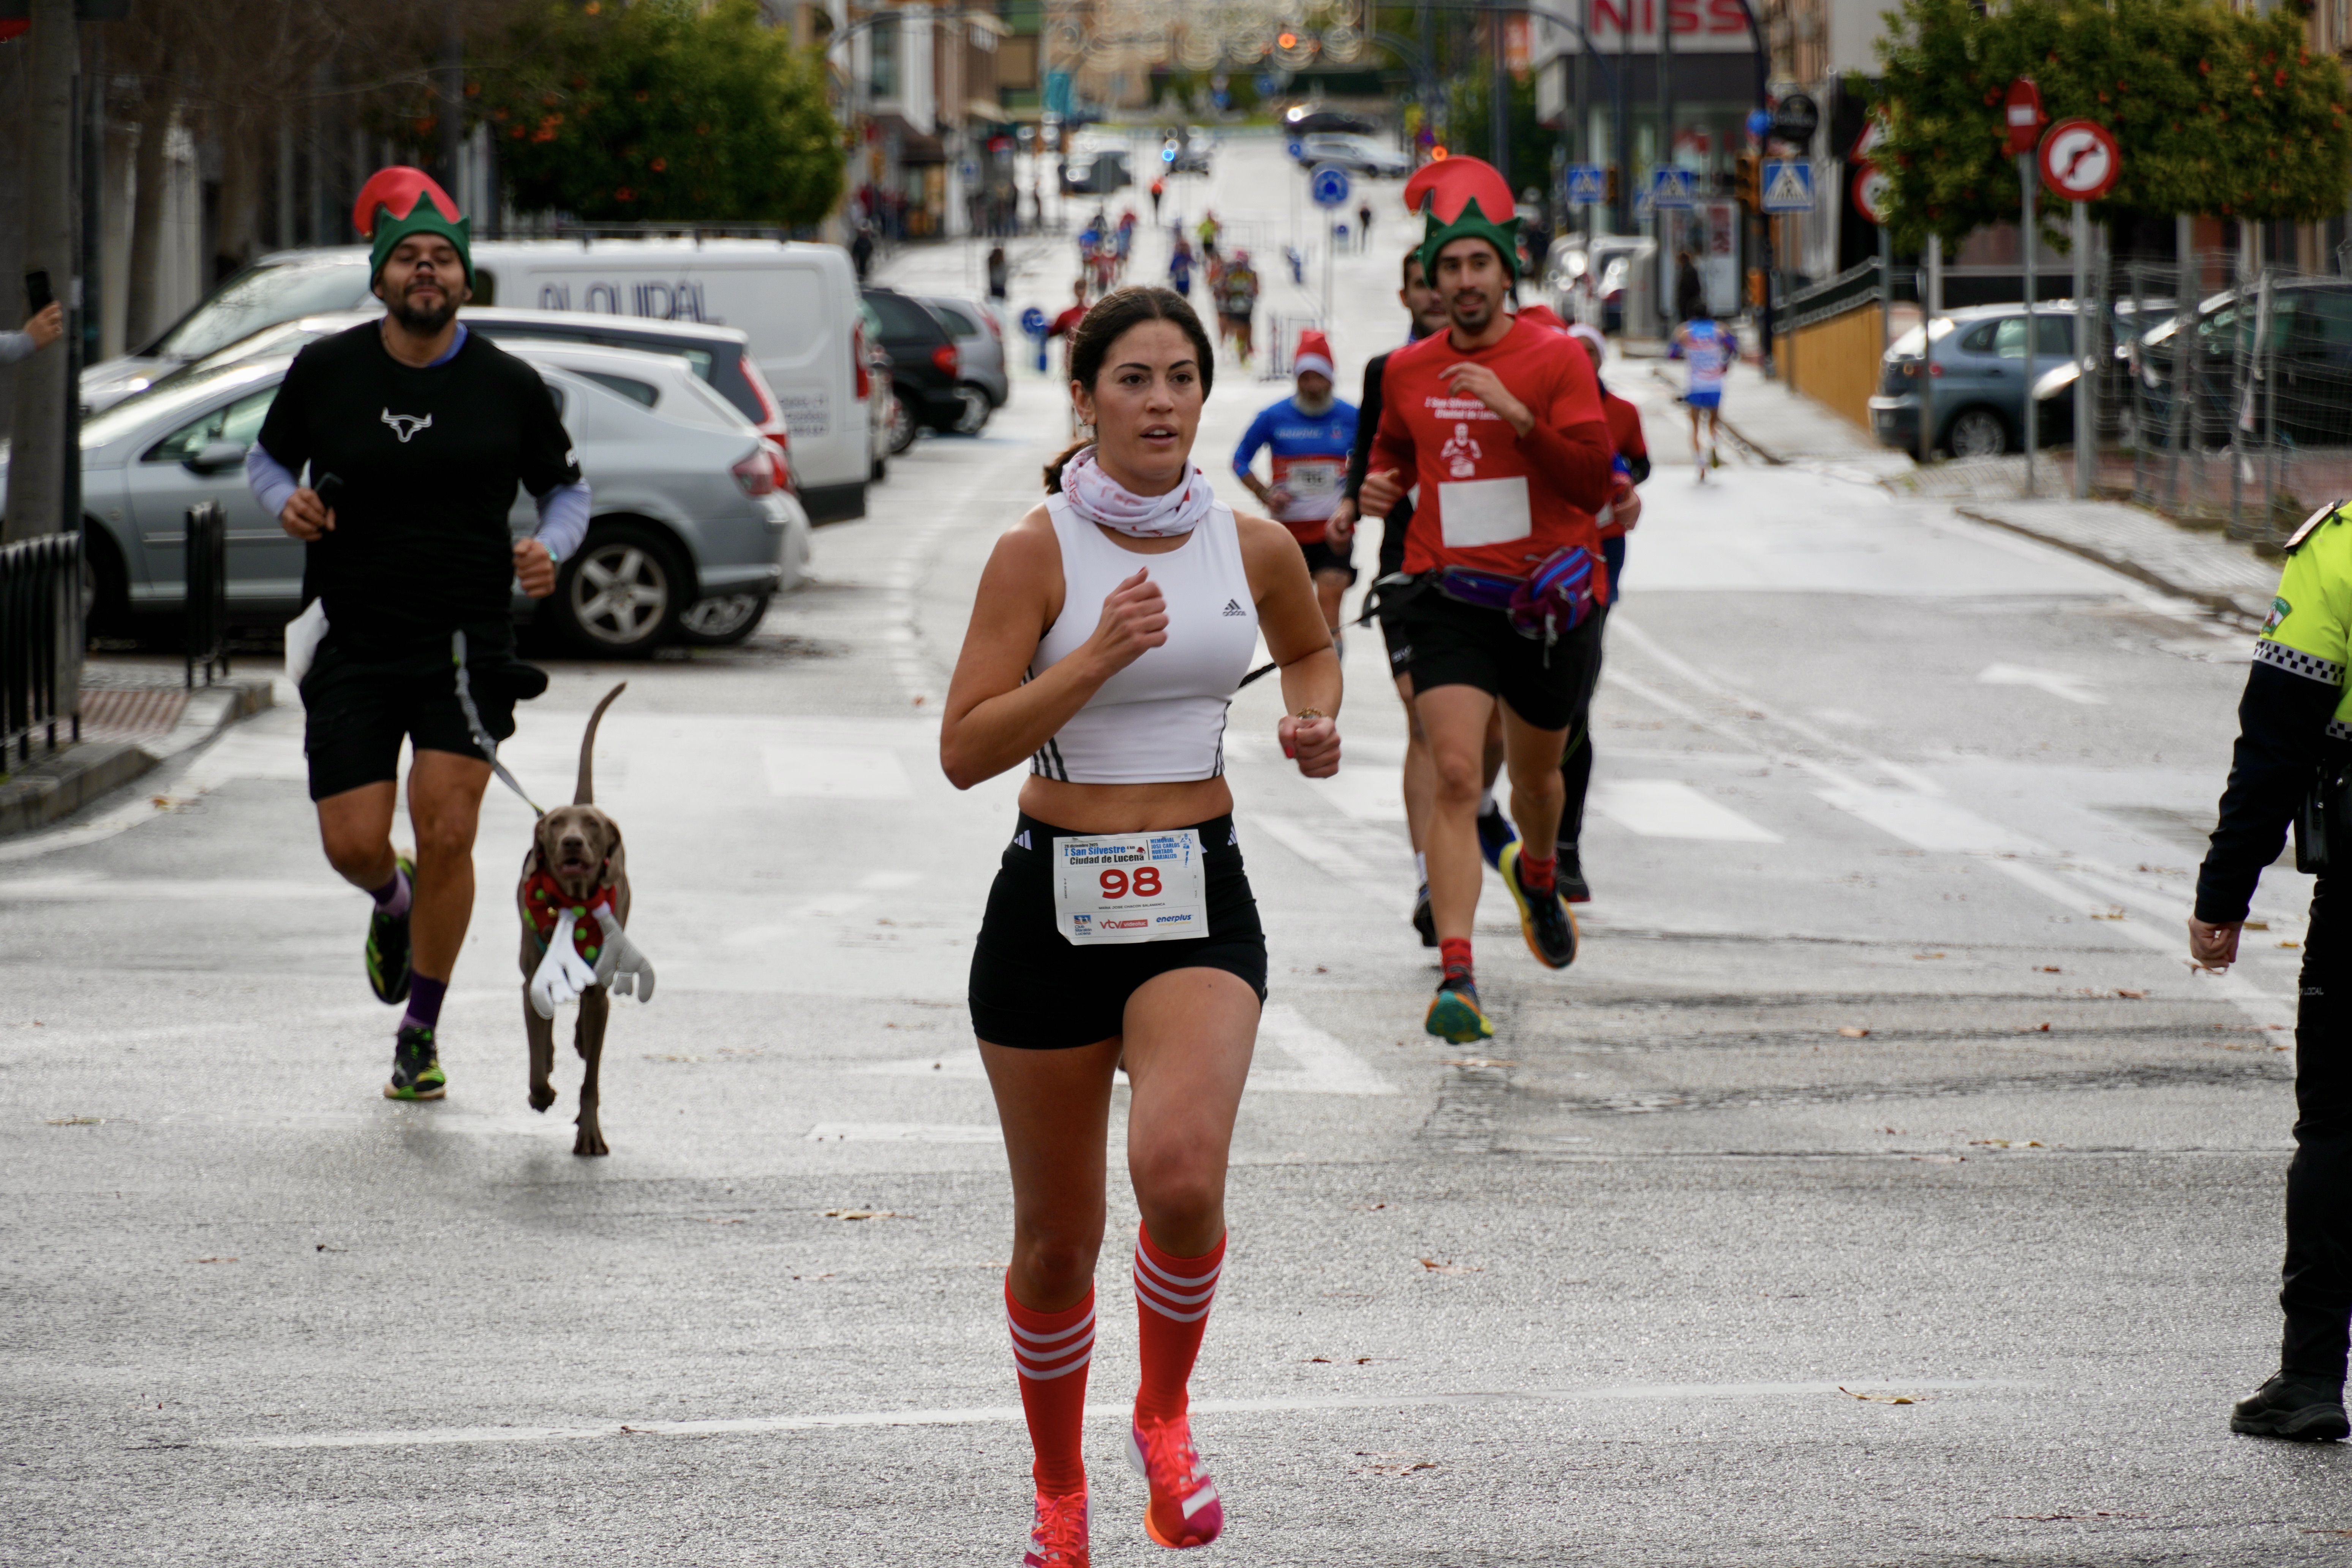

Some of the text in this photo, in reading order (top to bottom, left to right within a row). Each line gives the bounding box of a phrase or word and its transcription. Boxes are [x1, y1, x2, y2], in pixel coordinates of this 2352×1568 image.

[1088, 846, 1125, 855] Silvestre
[1070, 856, 1099, 865] Ciudad
[1114, 854, 1144, 863] Lucena
[1099, 866, 1162, 899] 98
[1156, 914, 1192, 923] enerplus
